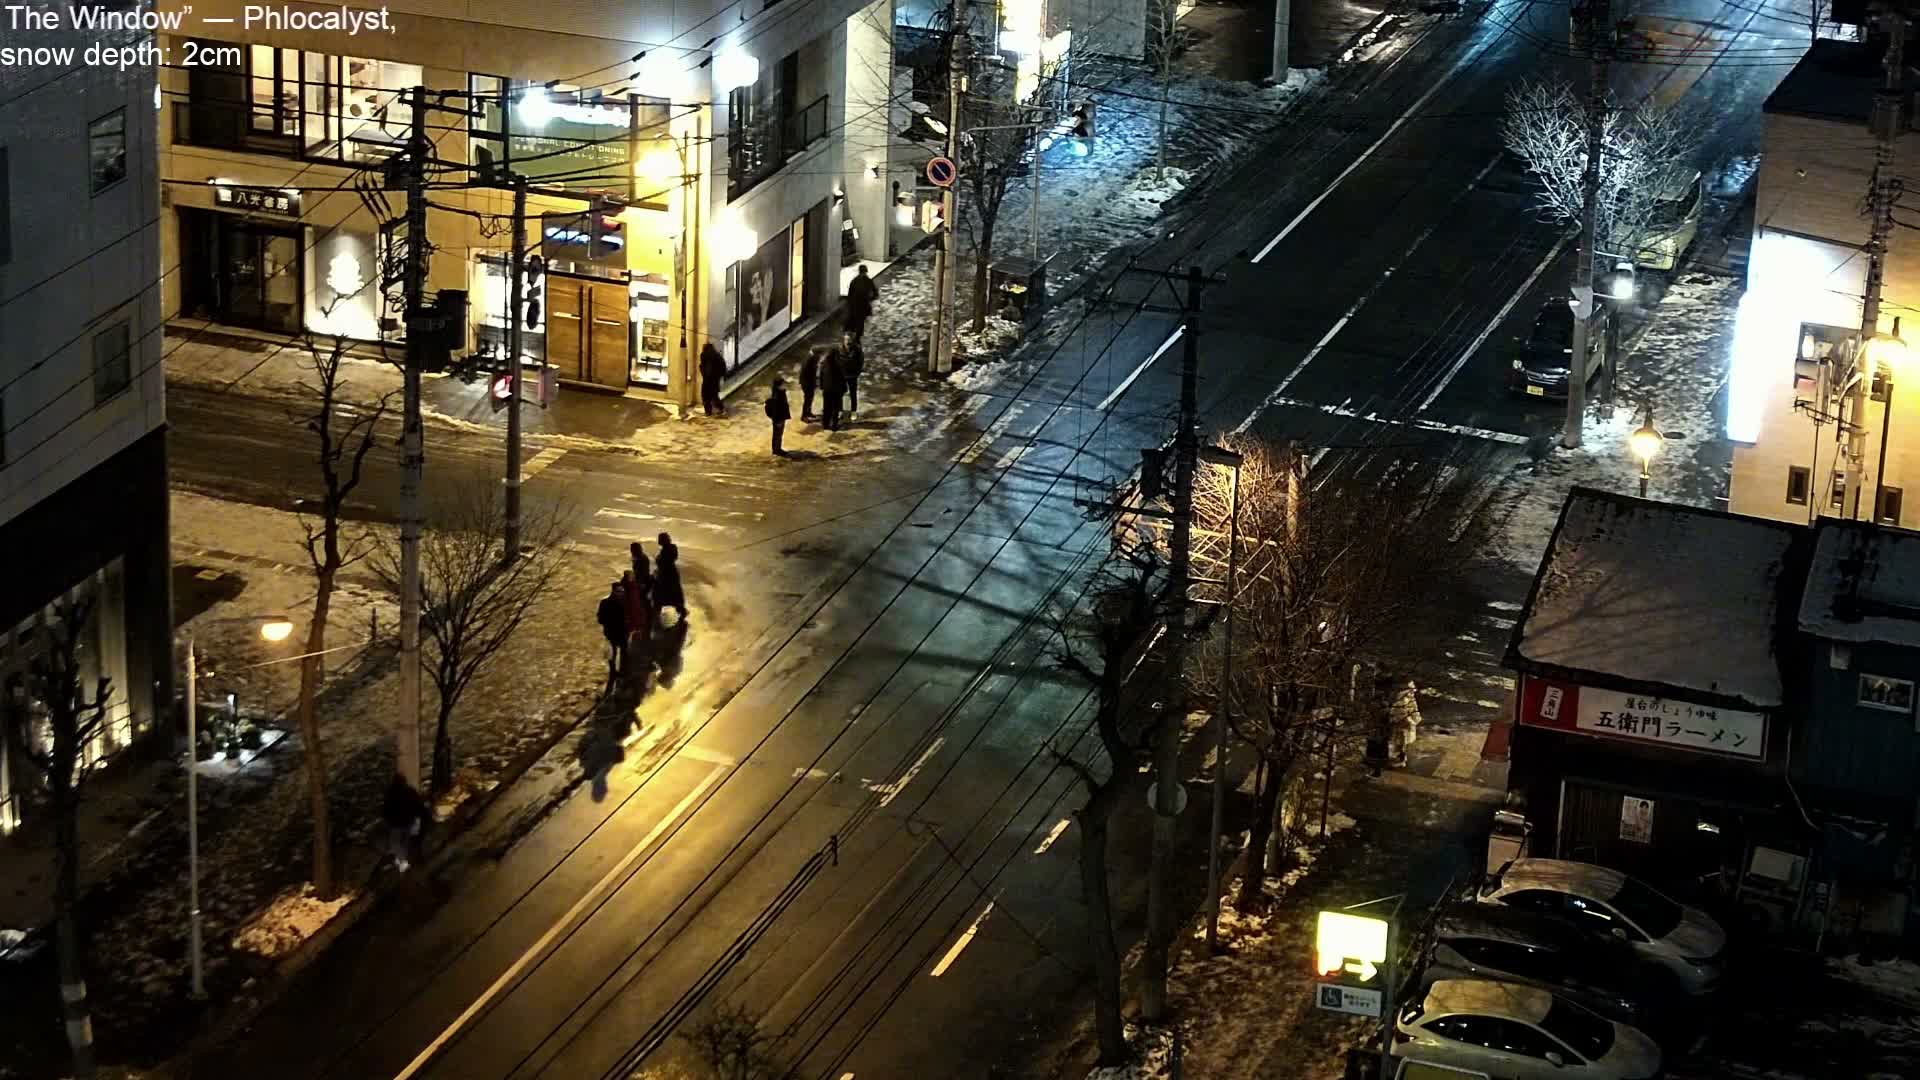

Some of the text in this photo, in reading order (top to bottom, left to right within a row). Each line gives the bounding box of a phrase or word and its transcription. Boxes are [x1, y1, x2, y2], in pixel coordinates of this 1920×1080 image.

[1594, 710, 1749, 748] 五衛門ラーメン
